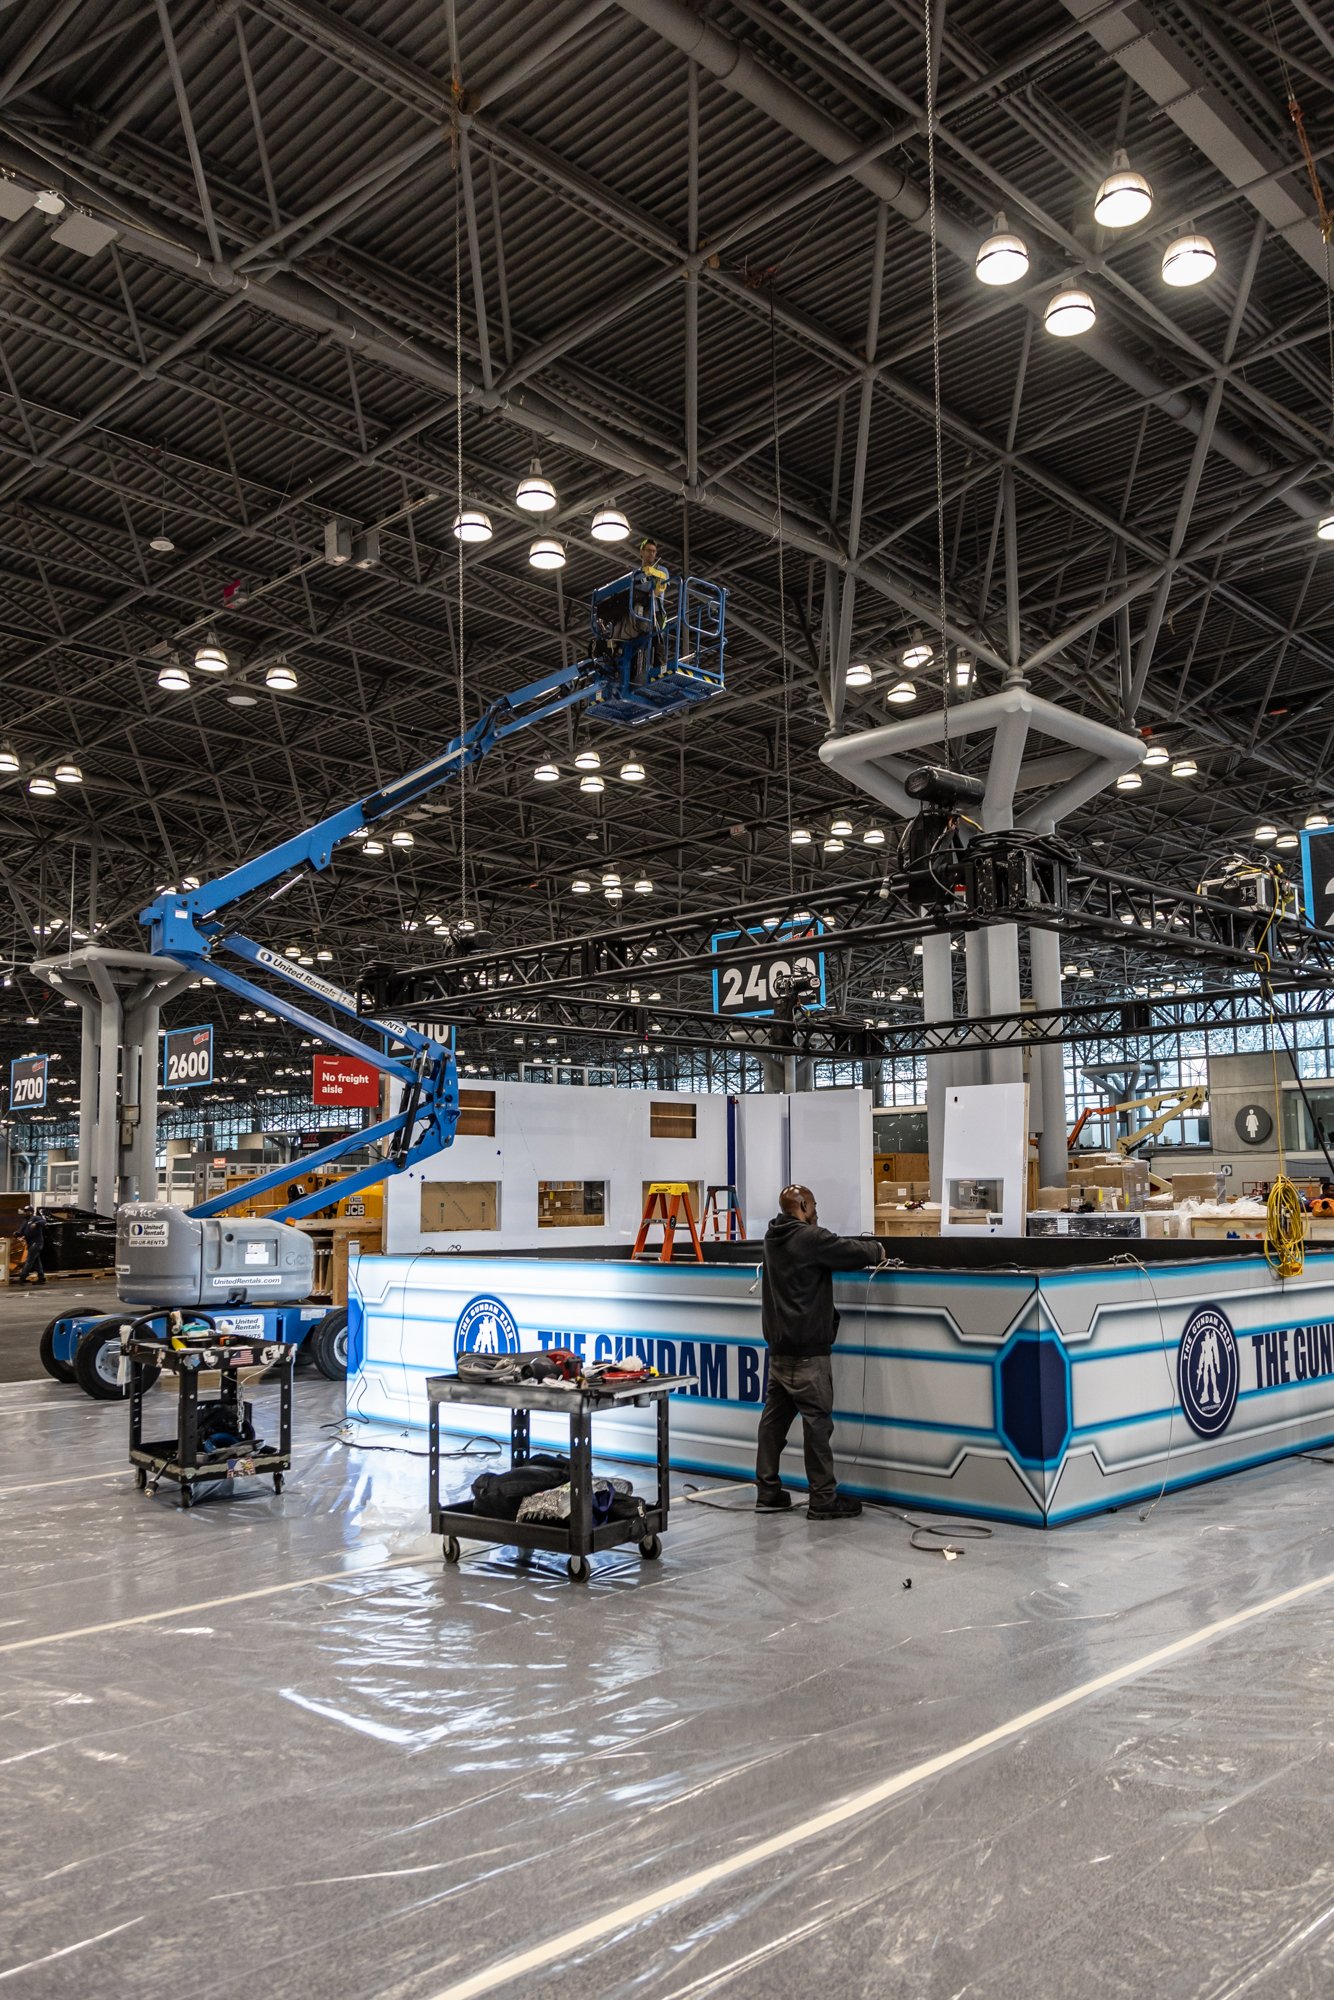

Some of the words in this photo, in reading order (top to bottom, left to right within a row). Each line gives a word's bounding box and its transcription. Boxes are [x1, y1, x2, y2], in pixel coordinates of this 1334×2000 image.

[273, 958, 304, 981] United
[303, 975, 336, 998] Rentals
[168, 1050, 209, 1080] 2600
[322, 1072, 336, 1082] No
[338, 1073, 369, 1085] freight
[14, 1076, 43, 1101] 2700
[322, 1084, 343, 1094] aisle
[345, 1204, 365, 1216] JCB
[214, 1277, 280, 1285] UnitedRentals.com
[461, 1316, 471, 1336] THE
[470, 1303, 499, 1317] GUNDAM
[500, 1313, 513, 1339] BASE
[1183, 1336, 1193, 1360] THE
[1192, 1315, 1219, 1333] GUNDAM
[1219, 1325, 1233, 1352] BASE
[1252, 1330, 1291, 1389] THE
[1293, 1323, 1334, 1381] GUN
